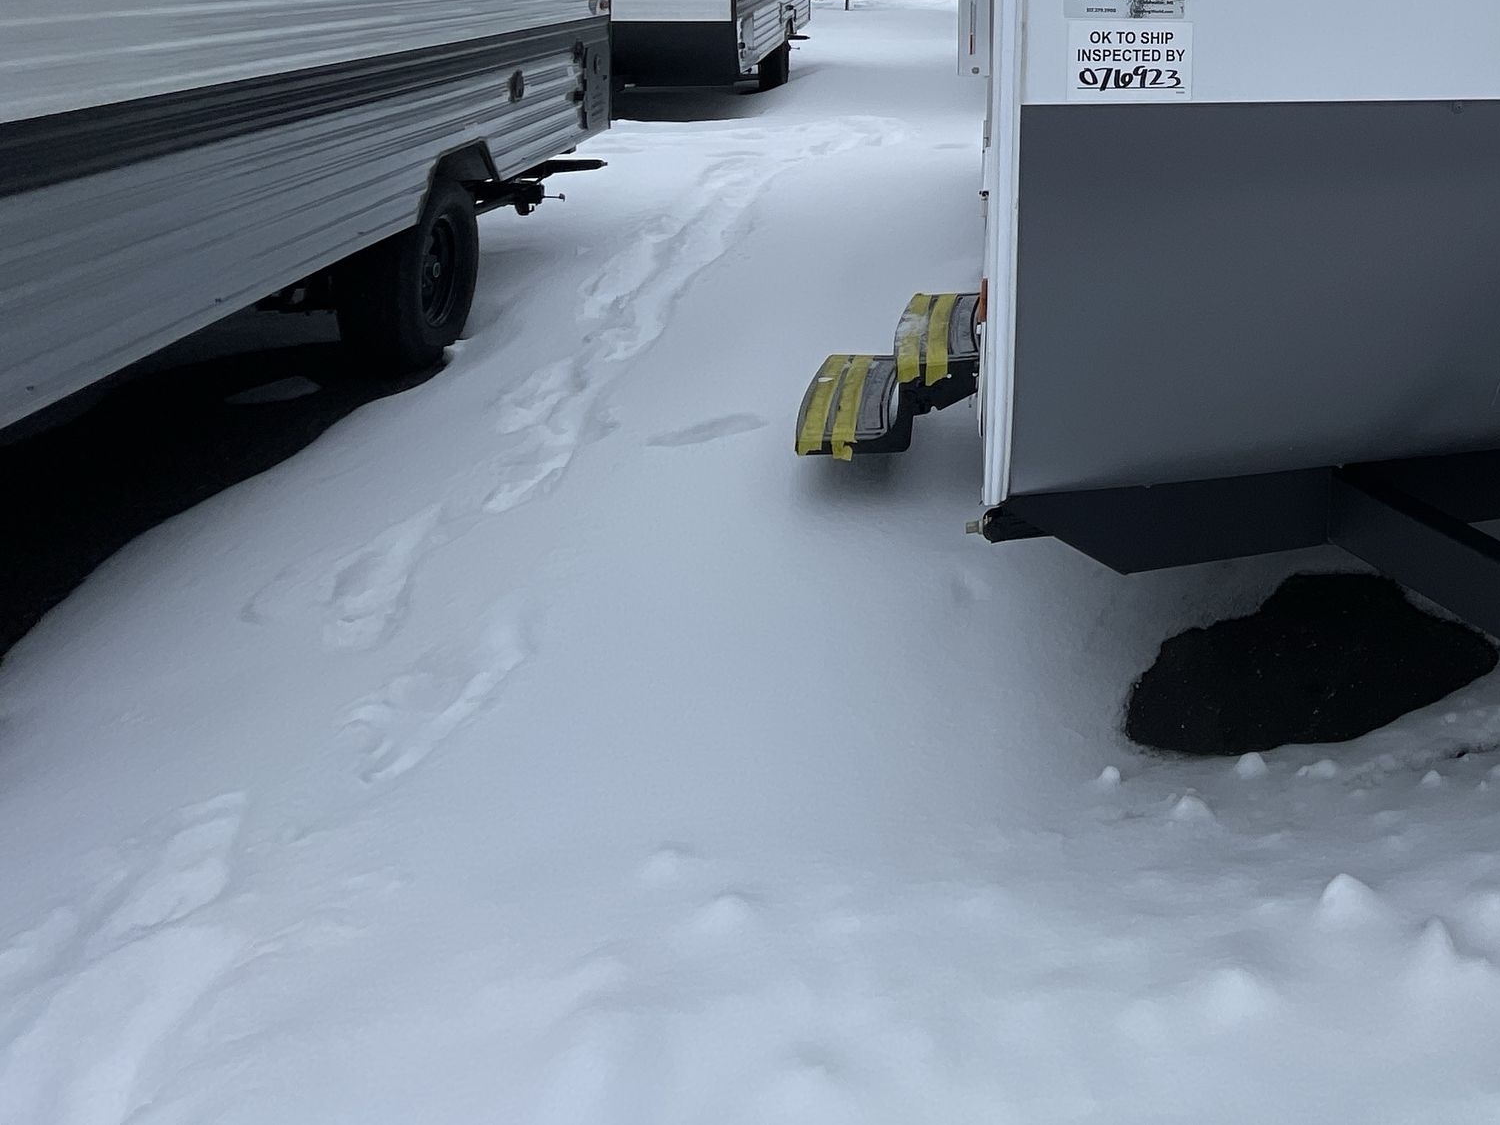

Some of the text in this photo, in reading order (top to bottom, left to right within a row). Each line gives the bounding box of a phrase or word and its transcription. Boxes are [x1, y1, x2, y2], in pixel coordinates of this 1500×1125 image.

[1090, 31, 1174, 44] OK TO SHIP
[1077, 49, 1185, 62] INSPECTED BY
